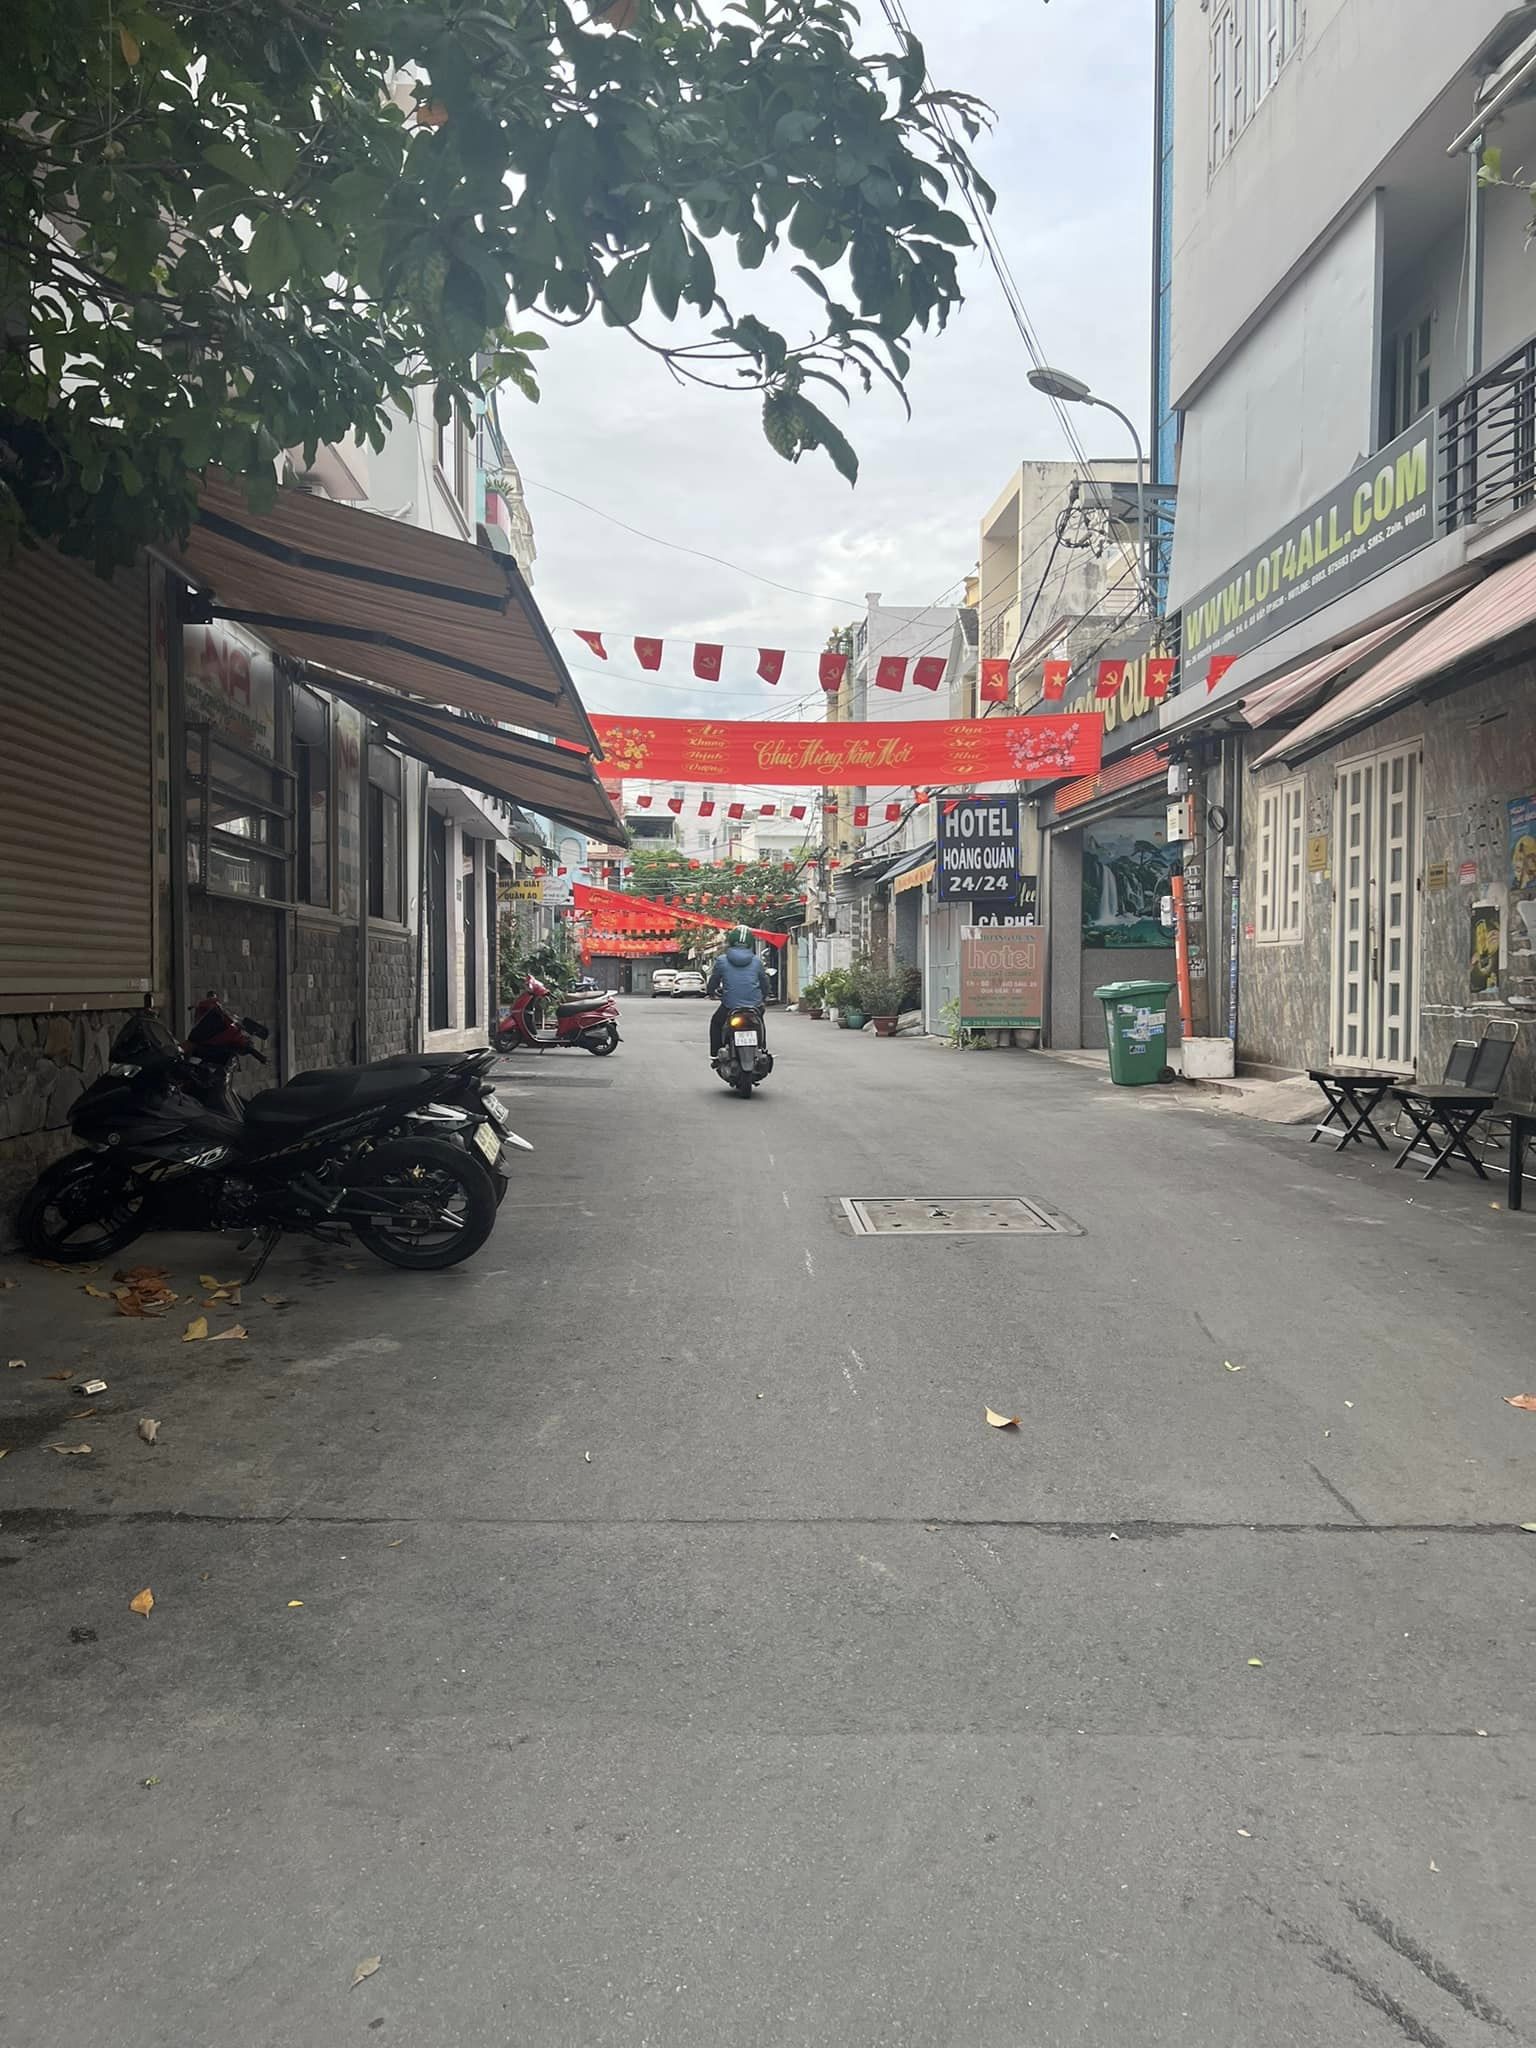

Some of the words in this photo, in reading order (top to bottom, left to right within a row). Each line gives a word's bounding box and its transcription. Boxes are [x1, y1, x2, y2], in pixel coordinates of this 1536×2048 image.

[1186, 437, 1428, 651] WWW.LOT4ALL.COM
[753, 739, 799, 770] Chúc
[797, 738, 844, 774] Mừng
[843, 739, 877, 768] Năm
[874, 736, 913, 769] Mới
[945, 807, 1014, 838] HOTEL
[943, 842, 982, 870] HOÀNG
[949, 875, 1009, 892] 24/24
[968, 940, 1036, 969] hotel
